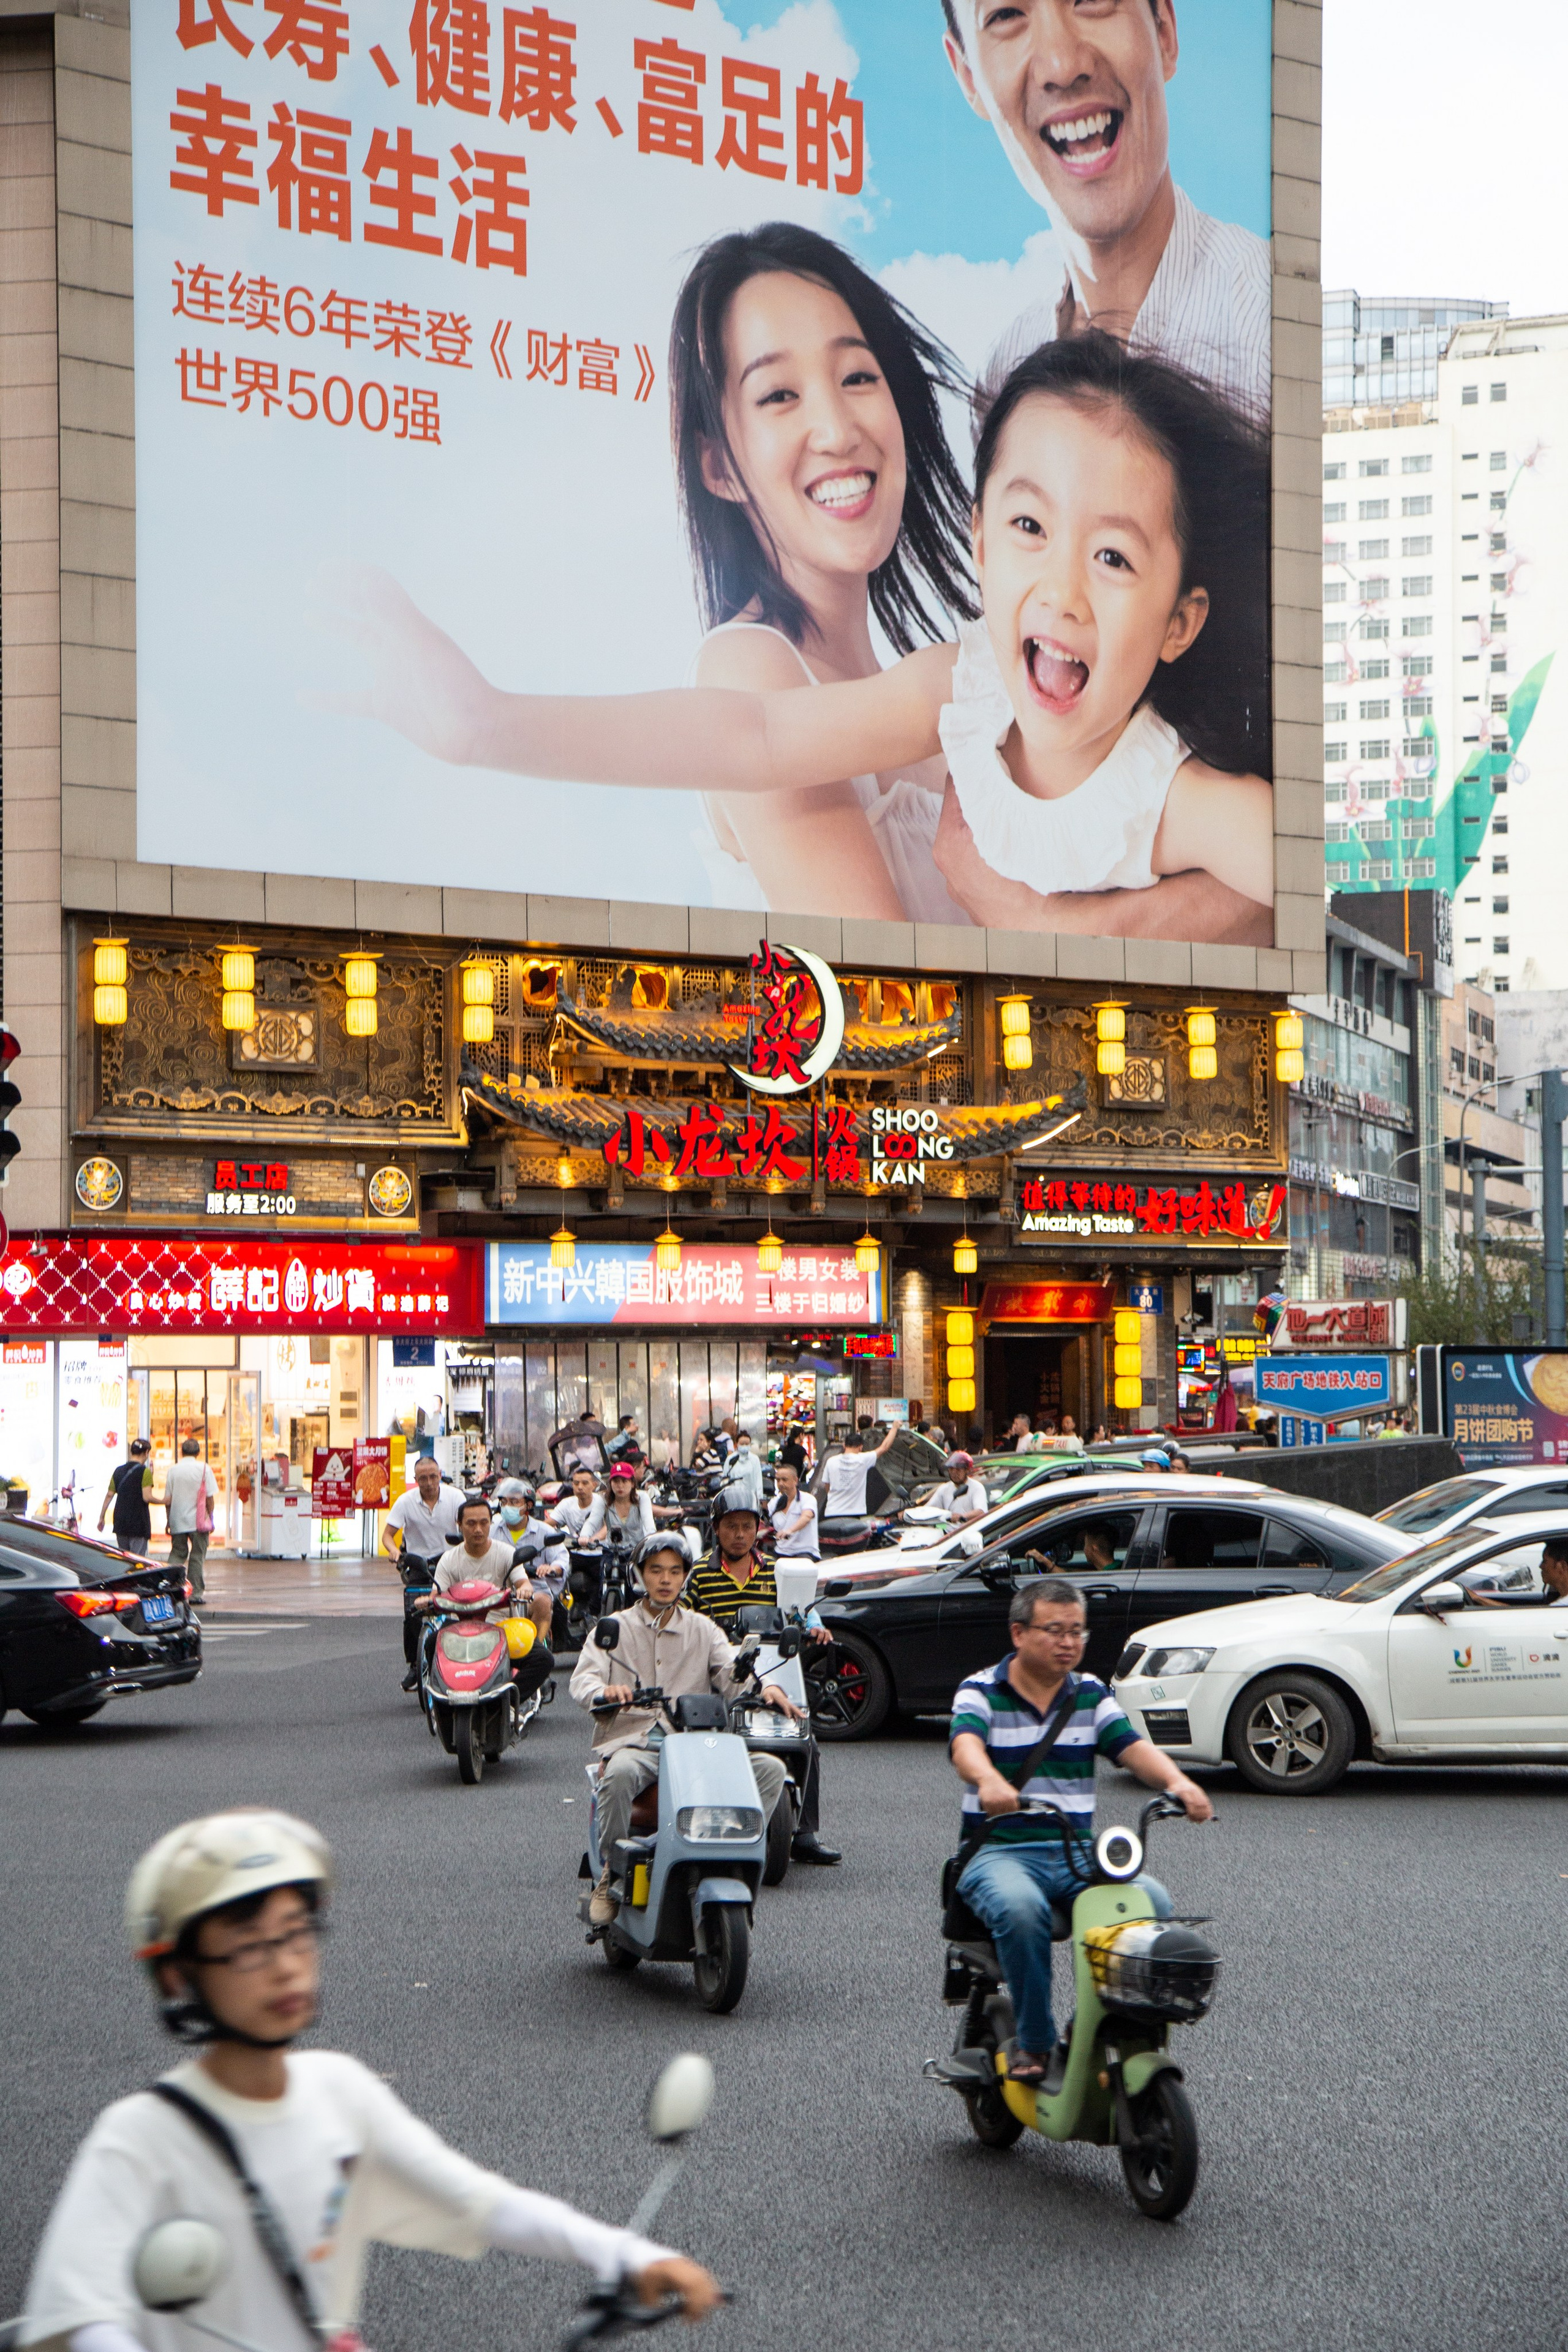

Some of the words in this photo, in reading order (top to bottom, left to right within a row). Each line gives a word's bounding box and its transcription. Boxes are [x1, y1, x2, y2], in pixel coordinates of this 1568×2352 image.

[170, 83, 530, 277] 幸福生活
[171, 259, 657, 402] 连续6年荣登《财富》
[175, 348, 442, 445] 世界500强
[723, 1003, 761, 1016] Amazing
[872, 1107, 938, 1132] SHOO
[603, 1104, 808, 1181] 小龙坎
[824, 1106, 860, 1182] 火锅
[873, 1134, 954, 1159] LOONG
[215, 1161, 288, 1190] 员工店
[872, 1162, 925, 1185] KAN
[1022, 1180, 1136, 1212] 值得等待的
[1022, 1213, 1091, 1236] Amazing
[1093, 1214, 1134, 1234] Taste
[755, 1291, 865, 1314] 三楼于归婚纱
[1140, 1295, 1153, 1308] 80
[410, 1346, 419, 1360] 2
[1262, 1370, 1382, 1390] 天府广场地铁入站口
[1453, 1418, 1534, 1442] 月饼团购节
